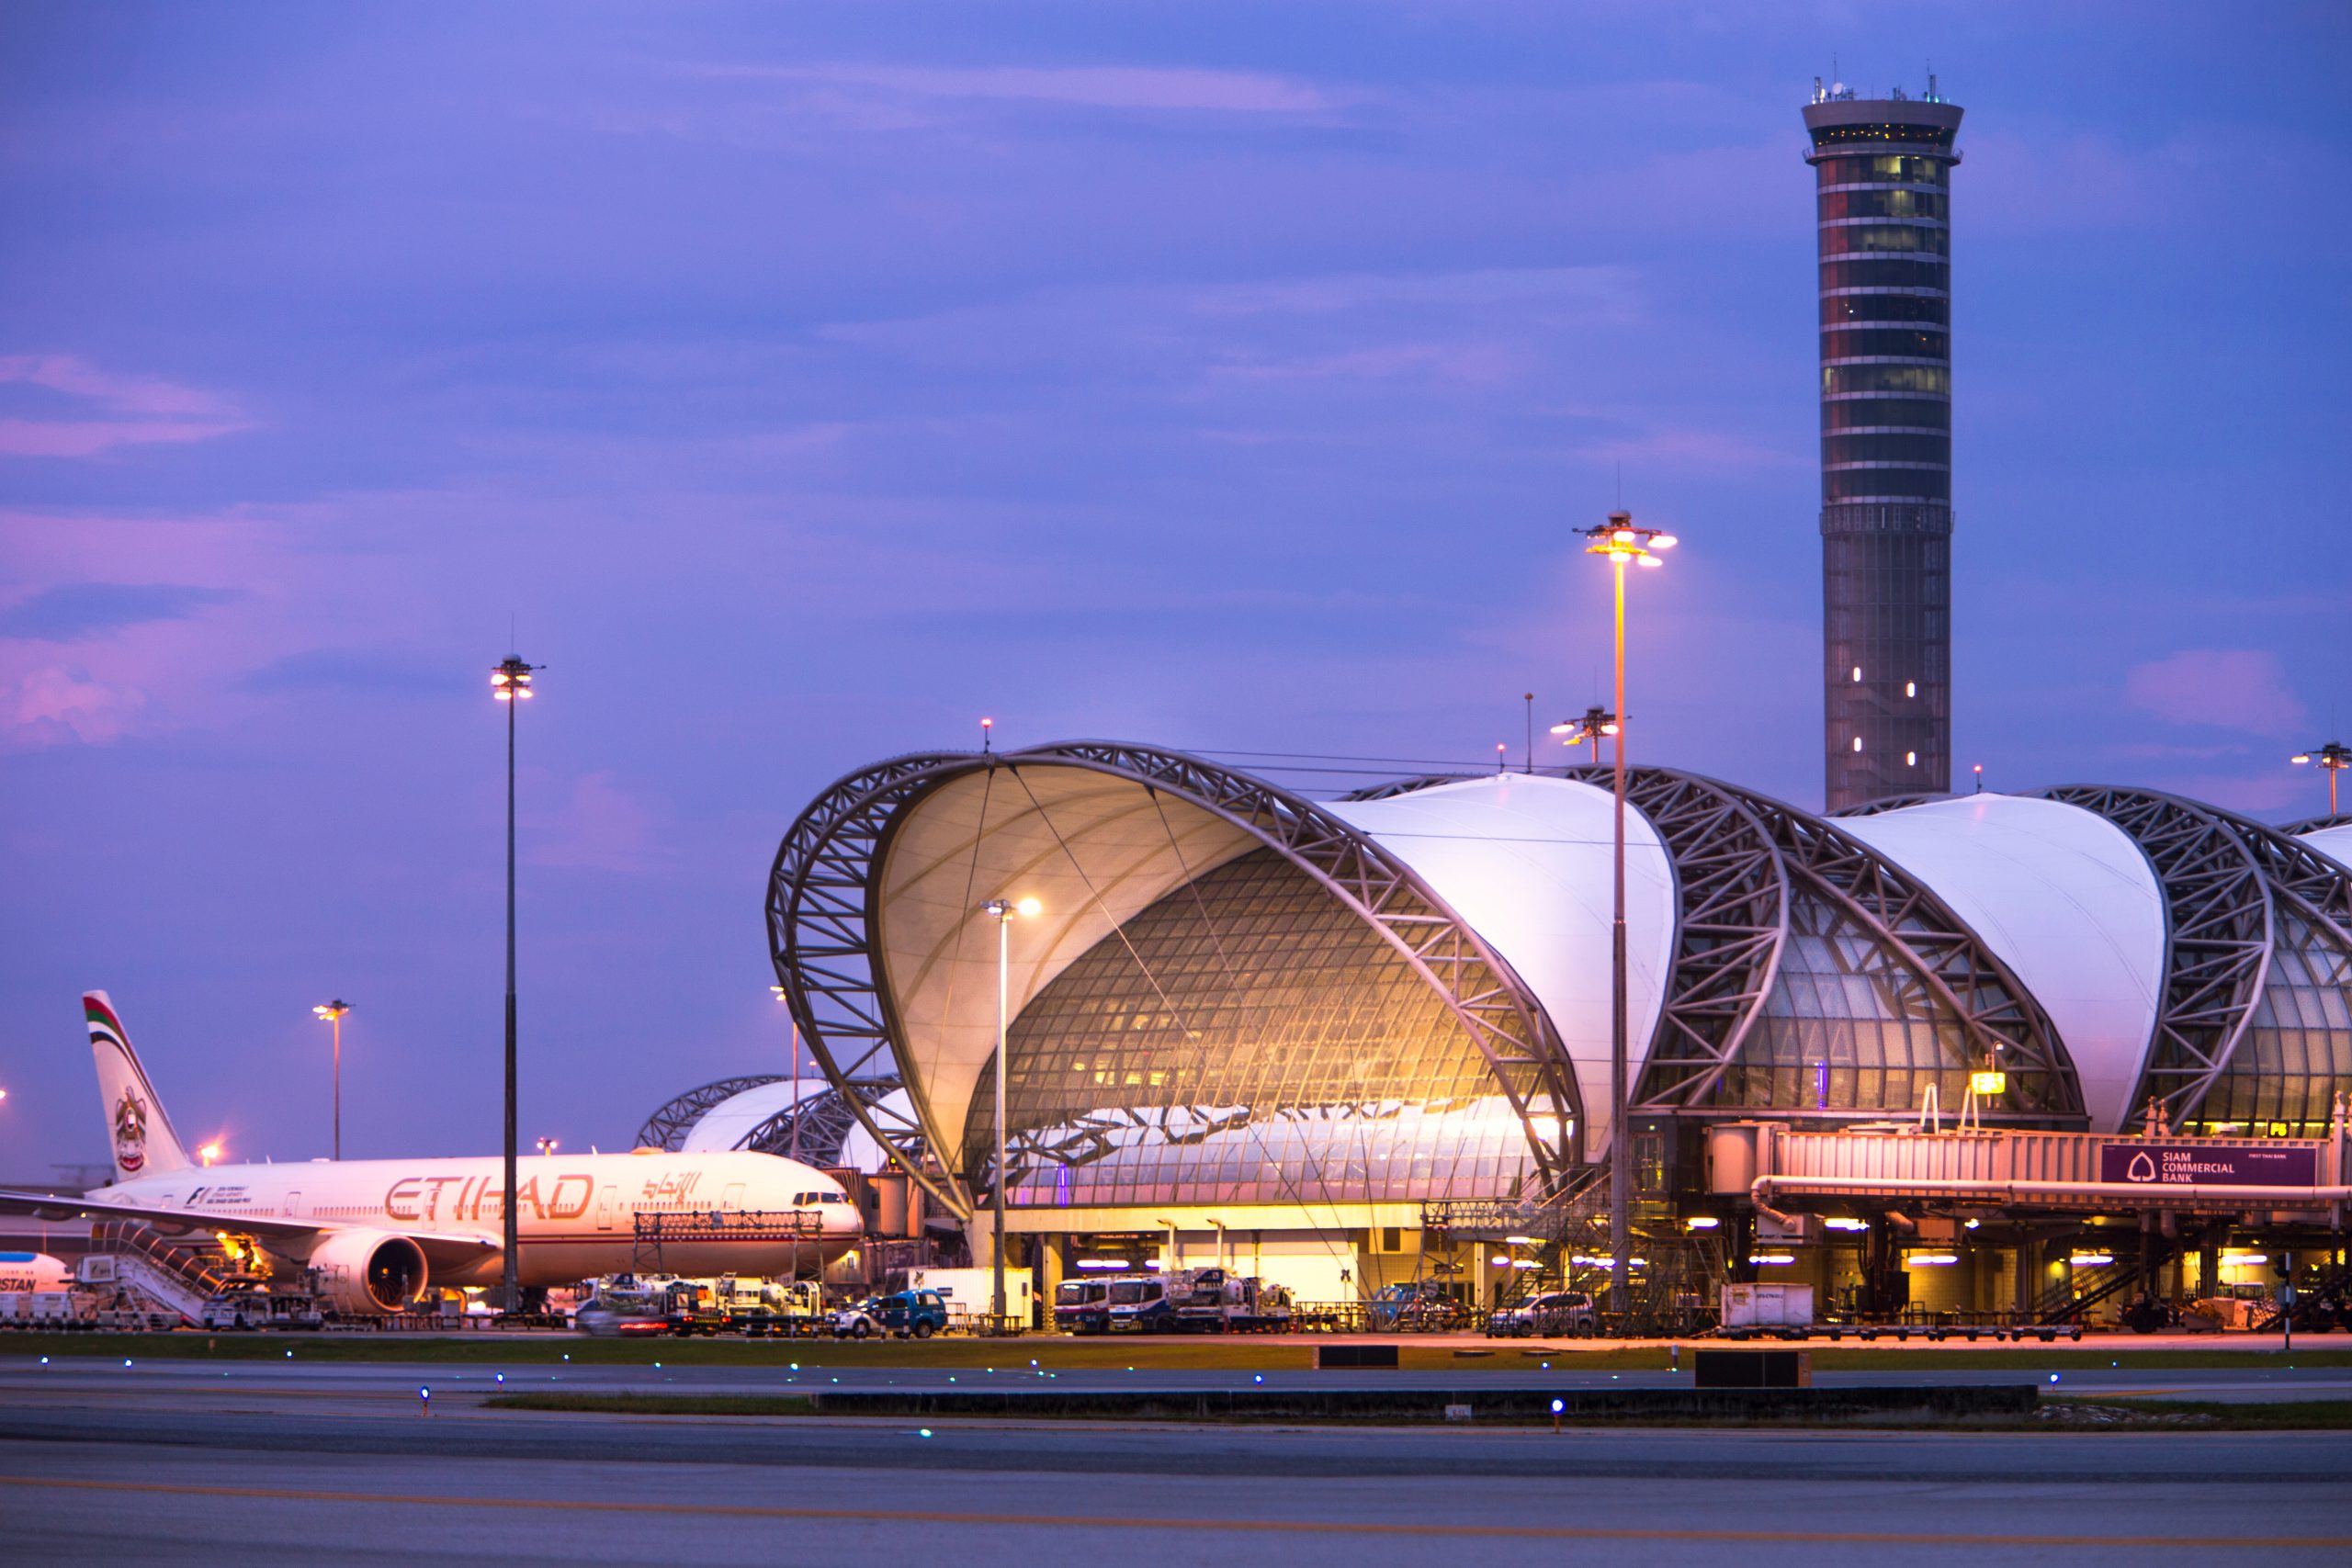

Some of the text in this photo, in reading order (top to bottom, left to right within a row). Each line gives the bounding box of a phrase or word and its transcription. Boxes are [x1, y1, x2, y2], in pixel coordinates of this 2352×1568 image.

[2162, 1152, 2191, 1162] SIAM
[2162, 1163, 2235, 1173] COMMERCIAL
[2162, 1173, 2193, 1183] BANK
[385, 1174, 594, 1221] ETIHAD
[0, 1278, 37, 1292] STAN
